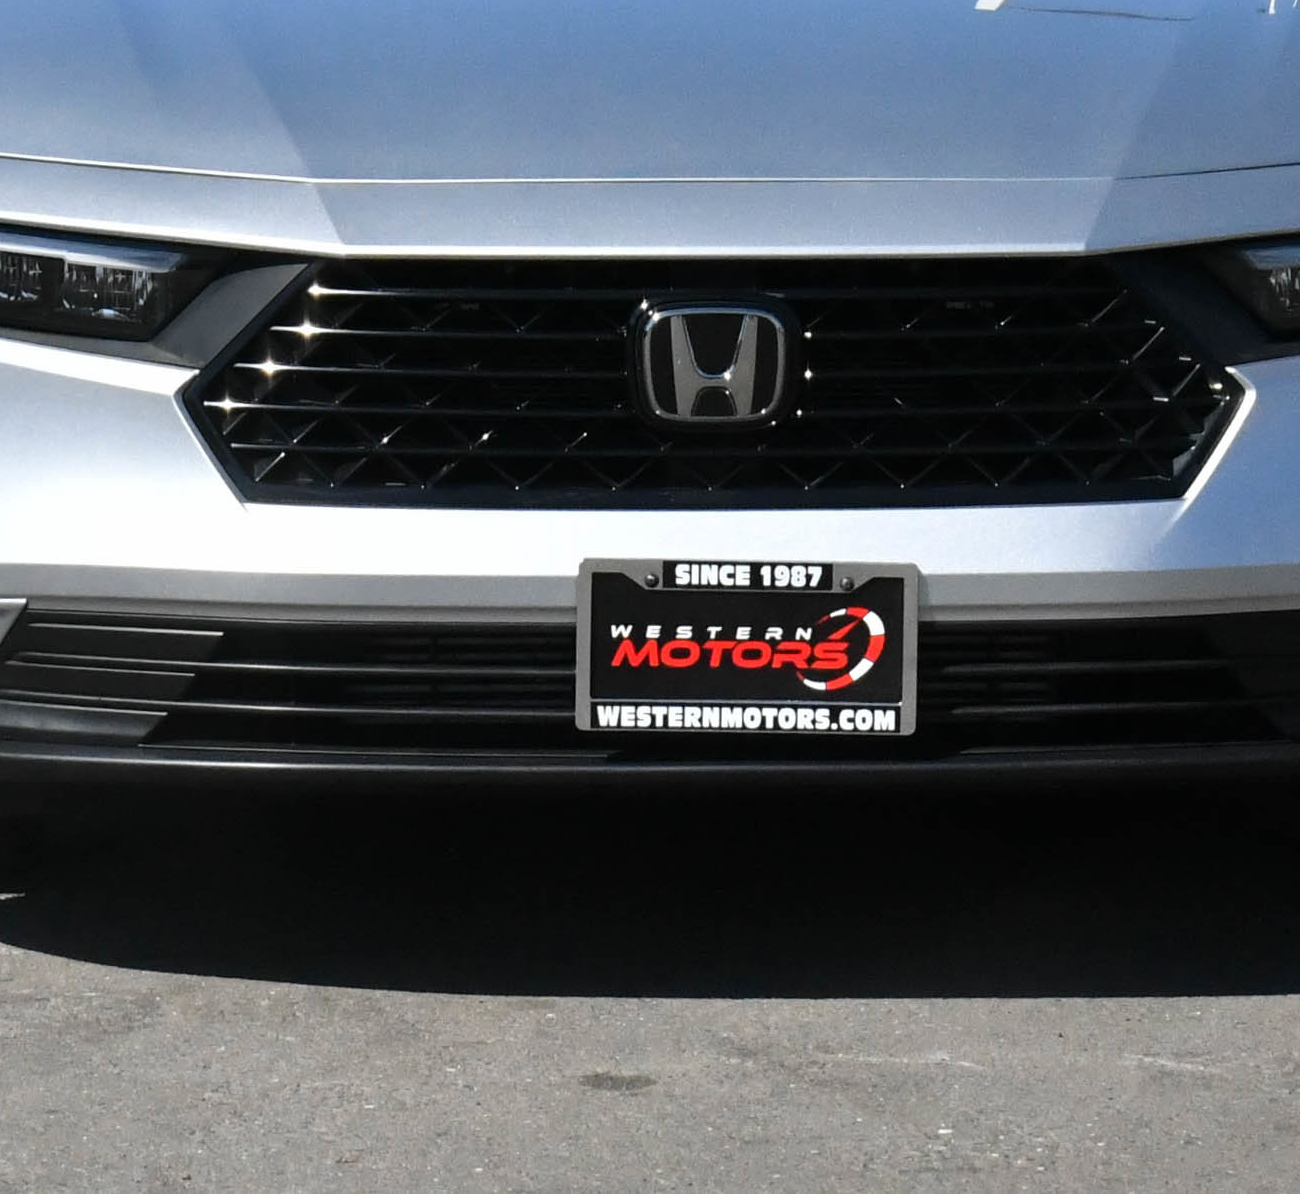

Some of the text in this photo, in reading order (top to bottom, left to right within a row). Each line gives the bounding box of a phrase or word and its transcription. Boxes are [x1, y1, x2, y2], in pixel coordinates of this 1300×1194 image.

[675, 564, 823, 588] SINCE 1987
[610, 624, 813, 641] WESTERN
[611, 639, 849, 670] MOTORS
[597, 705, 896, 732] WESTERNMOTORS.COM
